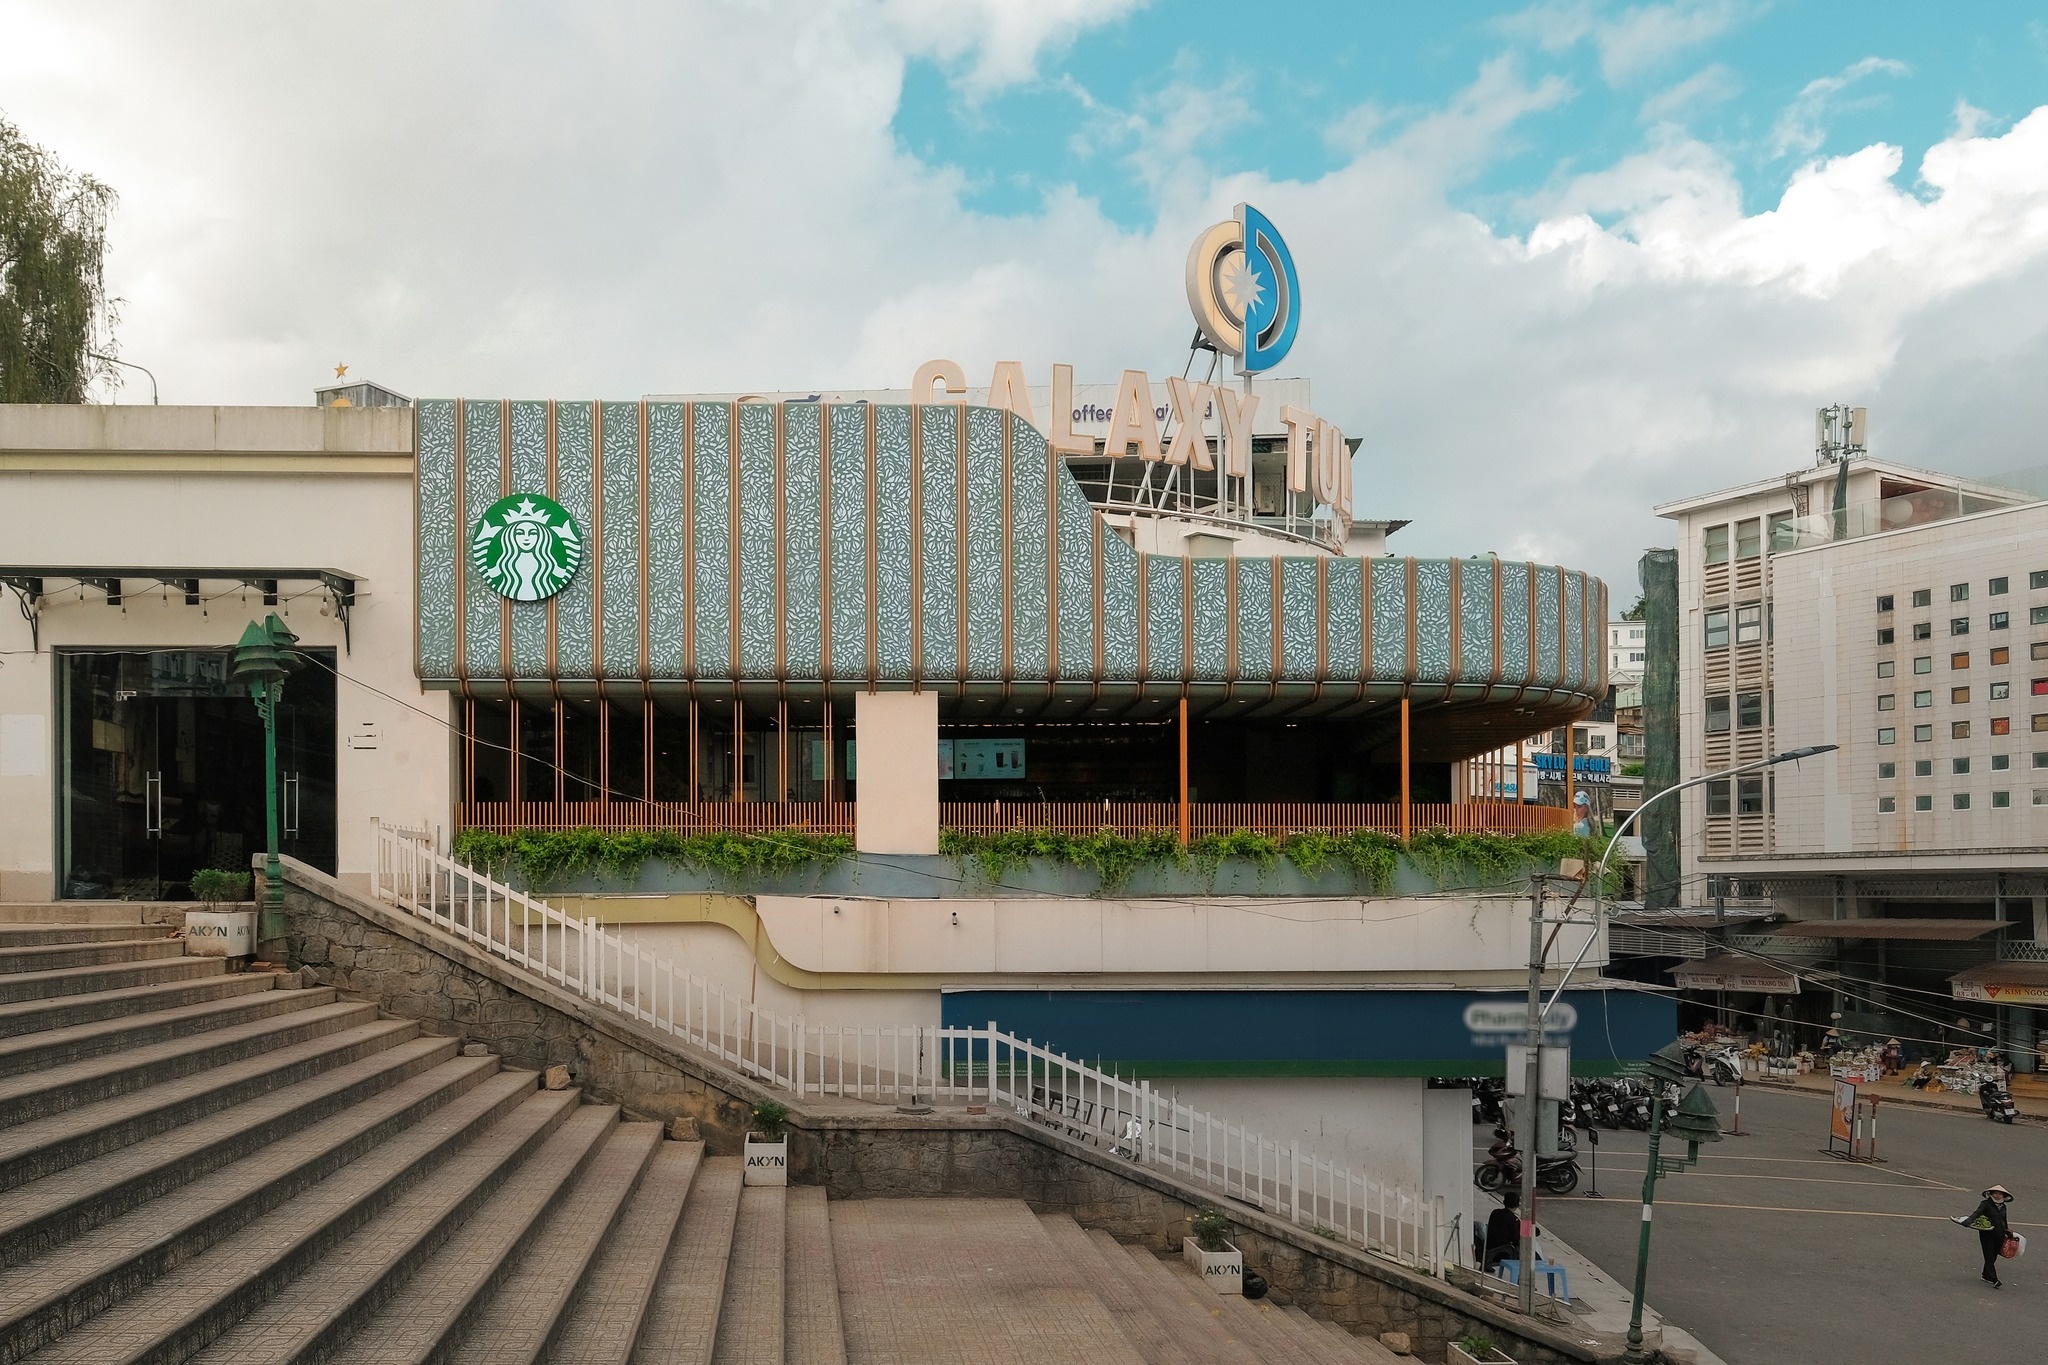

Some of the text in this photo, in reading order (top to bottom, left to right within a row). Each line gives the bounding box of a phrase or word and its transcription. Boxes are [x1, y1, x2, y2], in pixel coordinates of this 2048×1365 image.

[1072, 404, 1113, 422] offee
[2004, 988, 2022, 996] KIM
[747, 1156, 785, 1167] AKYN
[1205, 1264, 1241, 1276] AKYN
